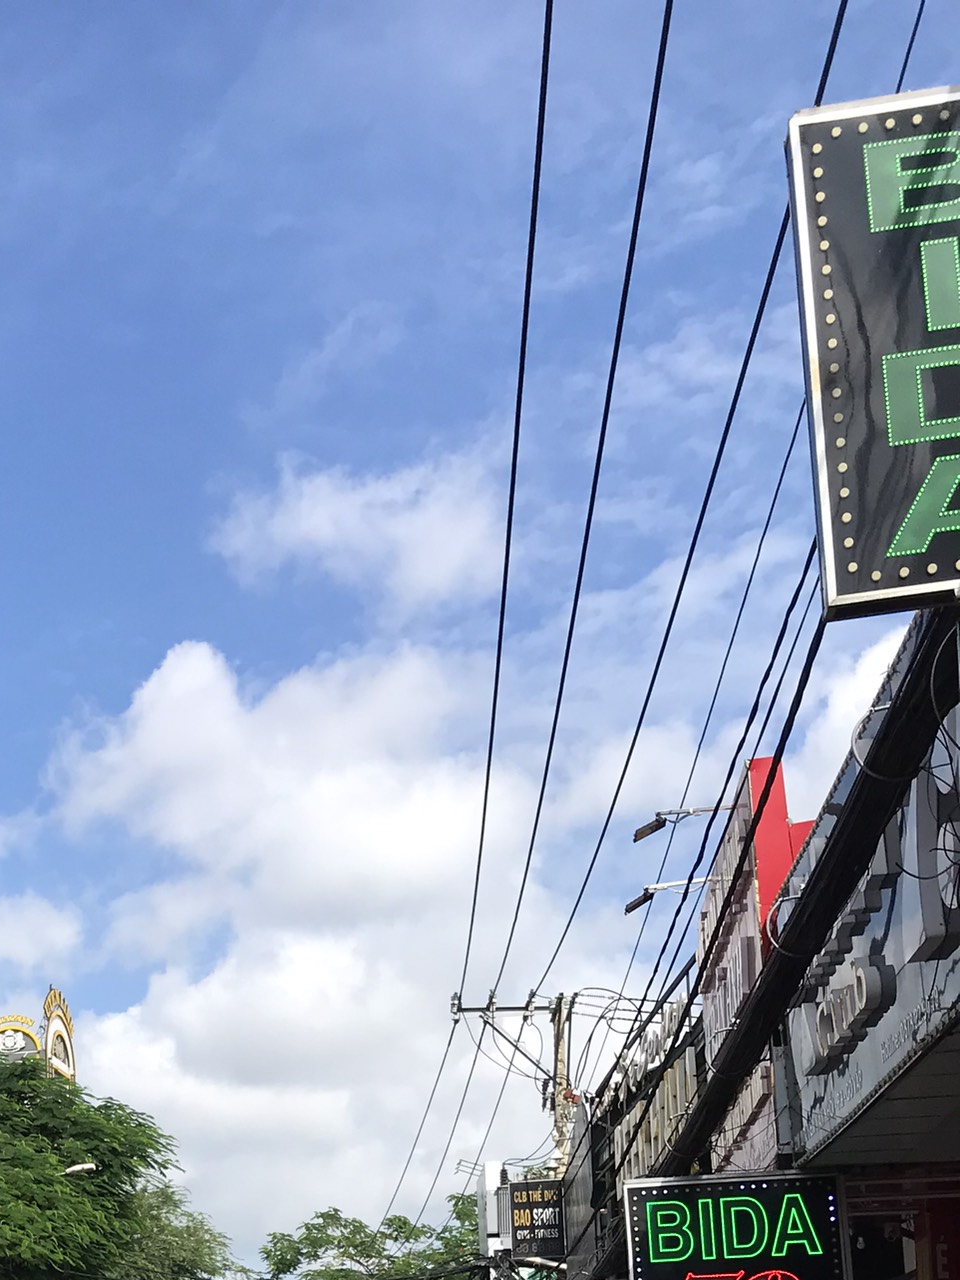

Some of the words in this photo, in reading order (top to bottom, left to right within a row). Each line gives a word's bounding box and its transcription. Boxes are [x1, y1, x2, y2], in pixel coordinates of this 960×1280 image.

[514, 1191, 528, 1203] CLB
[529, 1185, 542, 1203] THỂ
[514, 1209, 531, 1227] BAO
[532, 1207, 559, 1227] SPORT
[534, 1228, 559, 1240] FITNESS
[646, 1193, 823, 1263] BIDA
